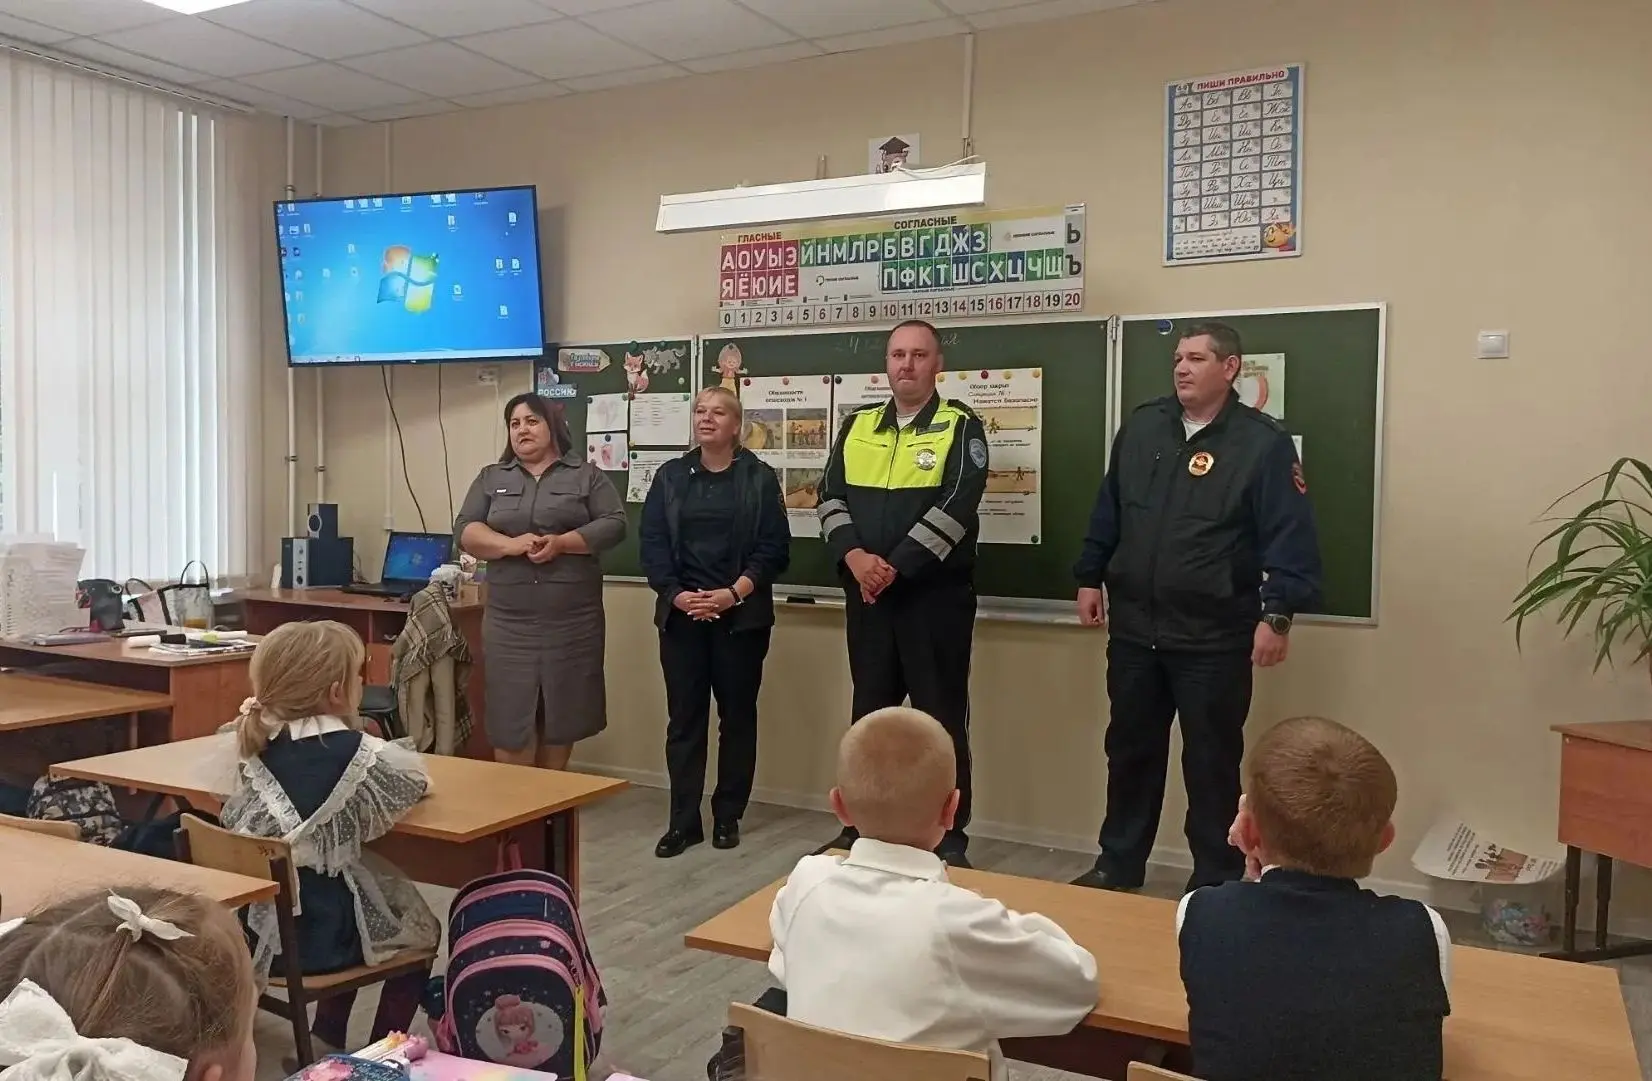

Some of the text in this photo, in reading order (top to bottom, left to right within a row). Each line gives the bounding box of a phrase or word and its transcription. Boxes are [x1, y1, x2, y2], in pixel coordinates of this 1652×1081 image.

[1197, 70, 1284, 89] ПИШИ ПРАВИЛЬНО
[894, 216, 957, 230] СОГЛАСНЫЕ
[738, 232, 782, 242] ГЛАСНЫЕ
[725, 292, 1080, 324] 0 1 2 3 4 5 6 7 8 9 10 11 12 13 14 15 16 17 18 19 20
